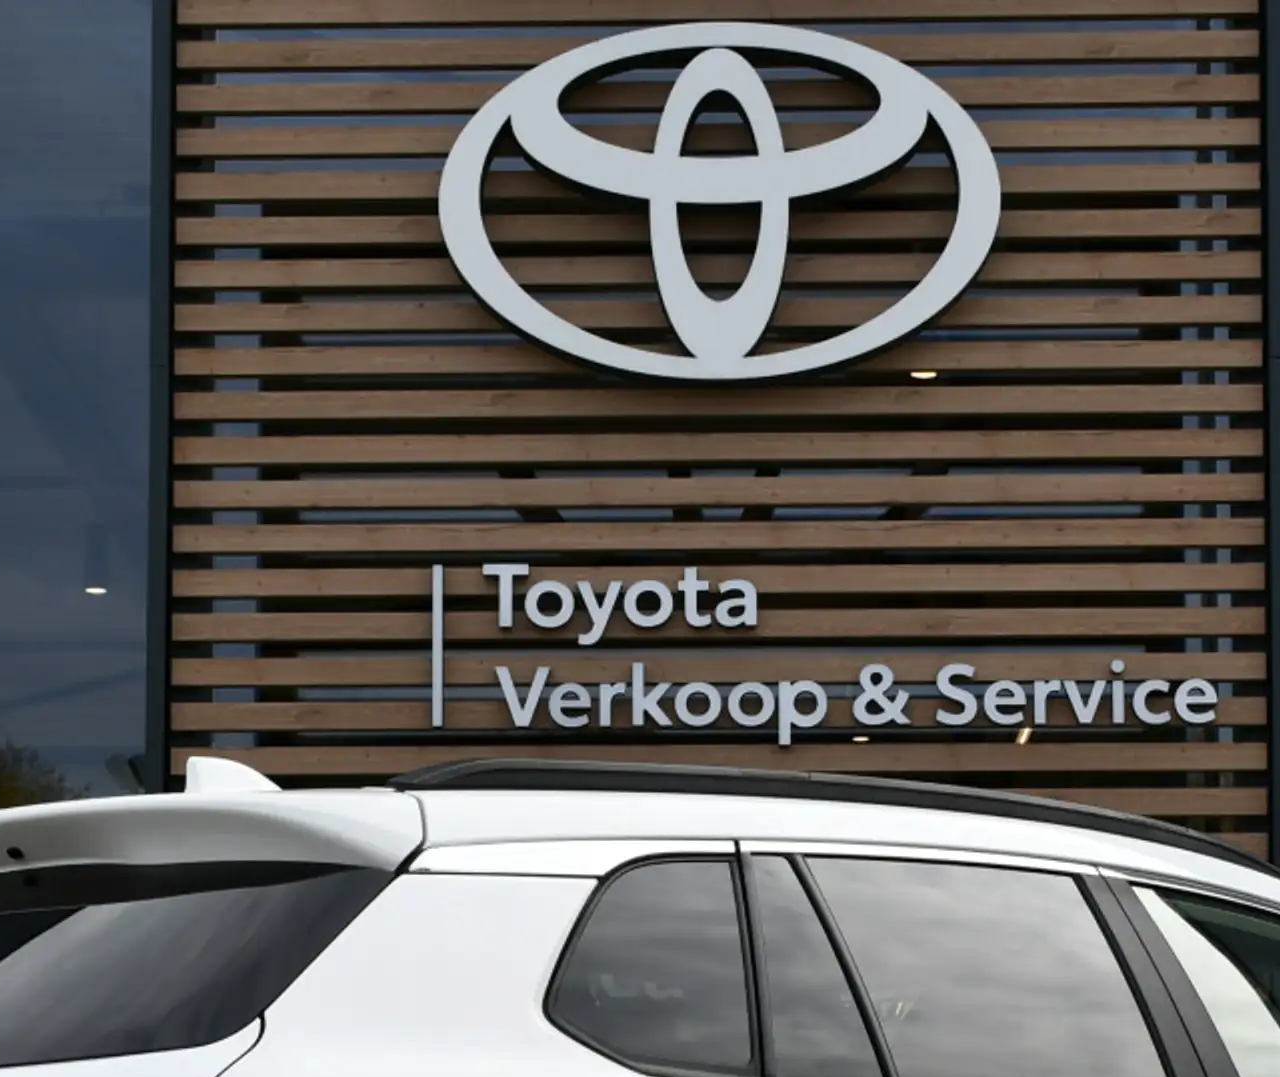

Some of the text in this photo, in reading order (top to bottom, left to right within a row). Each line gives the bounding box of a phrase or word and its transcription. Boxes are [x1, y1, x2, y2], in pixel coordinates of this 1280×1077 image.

[482, 564, 759, 646] Toyota
[495, 660, 1219, 745] Verkoop & Service
